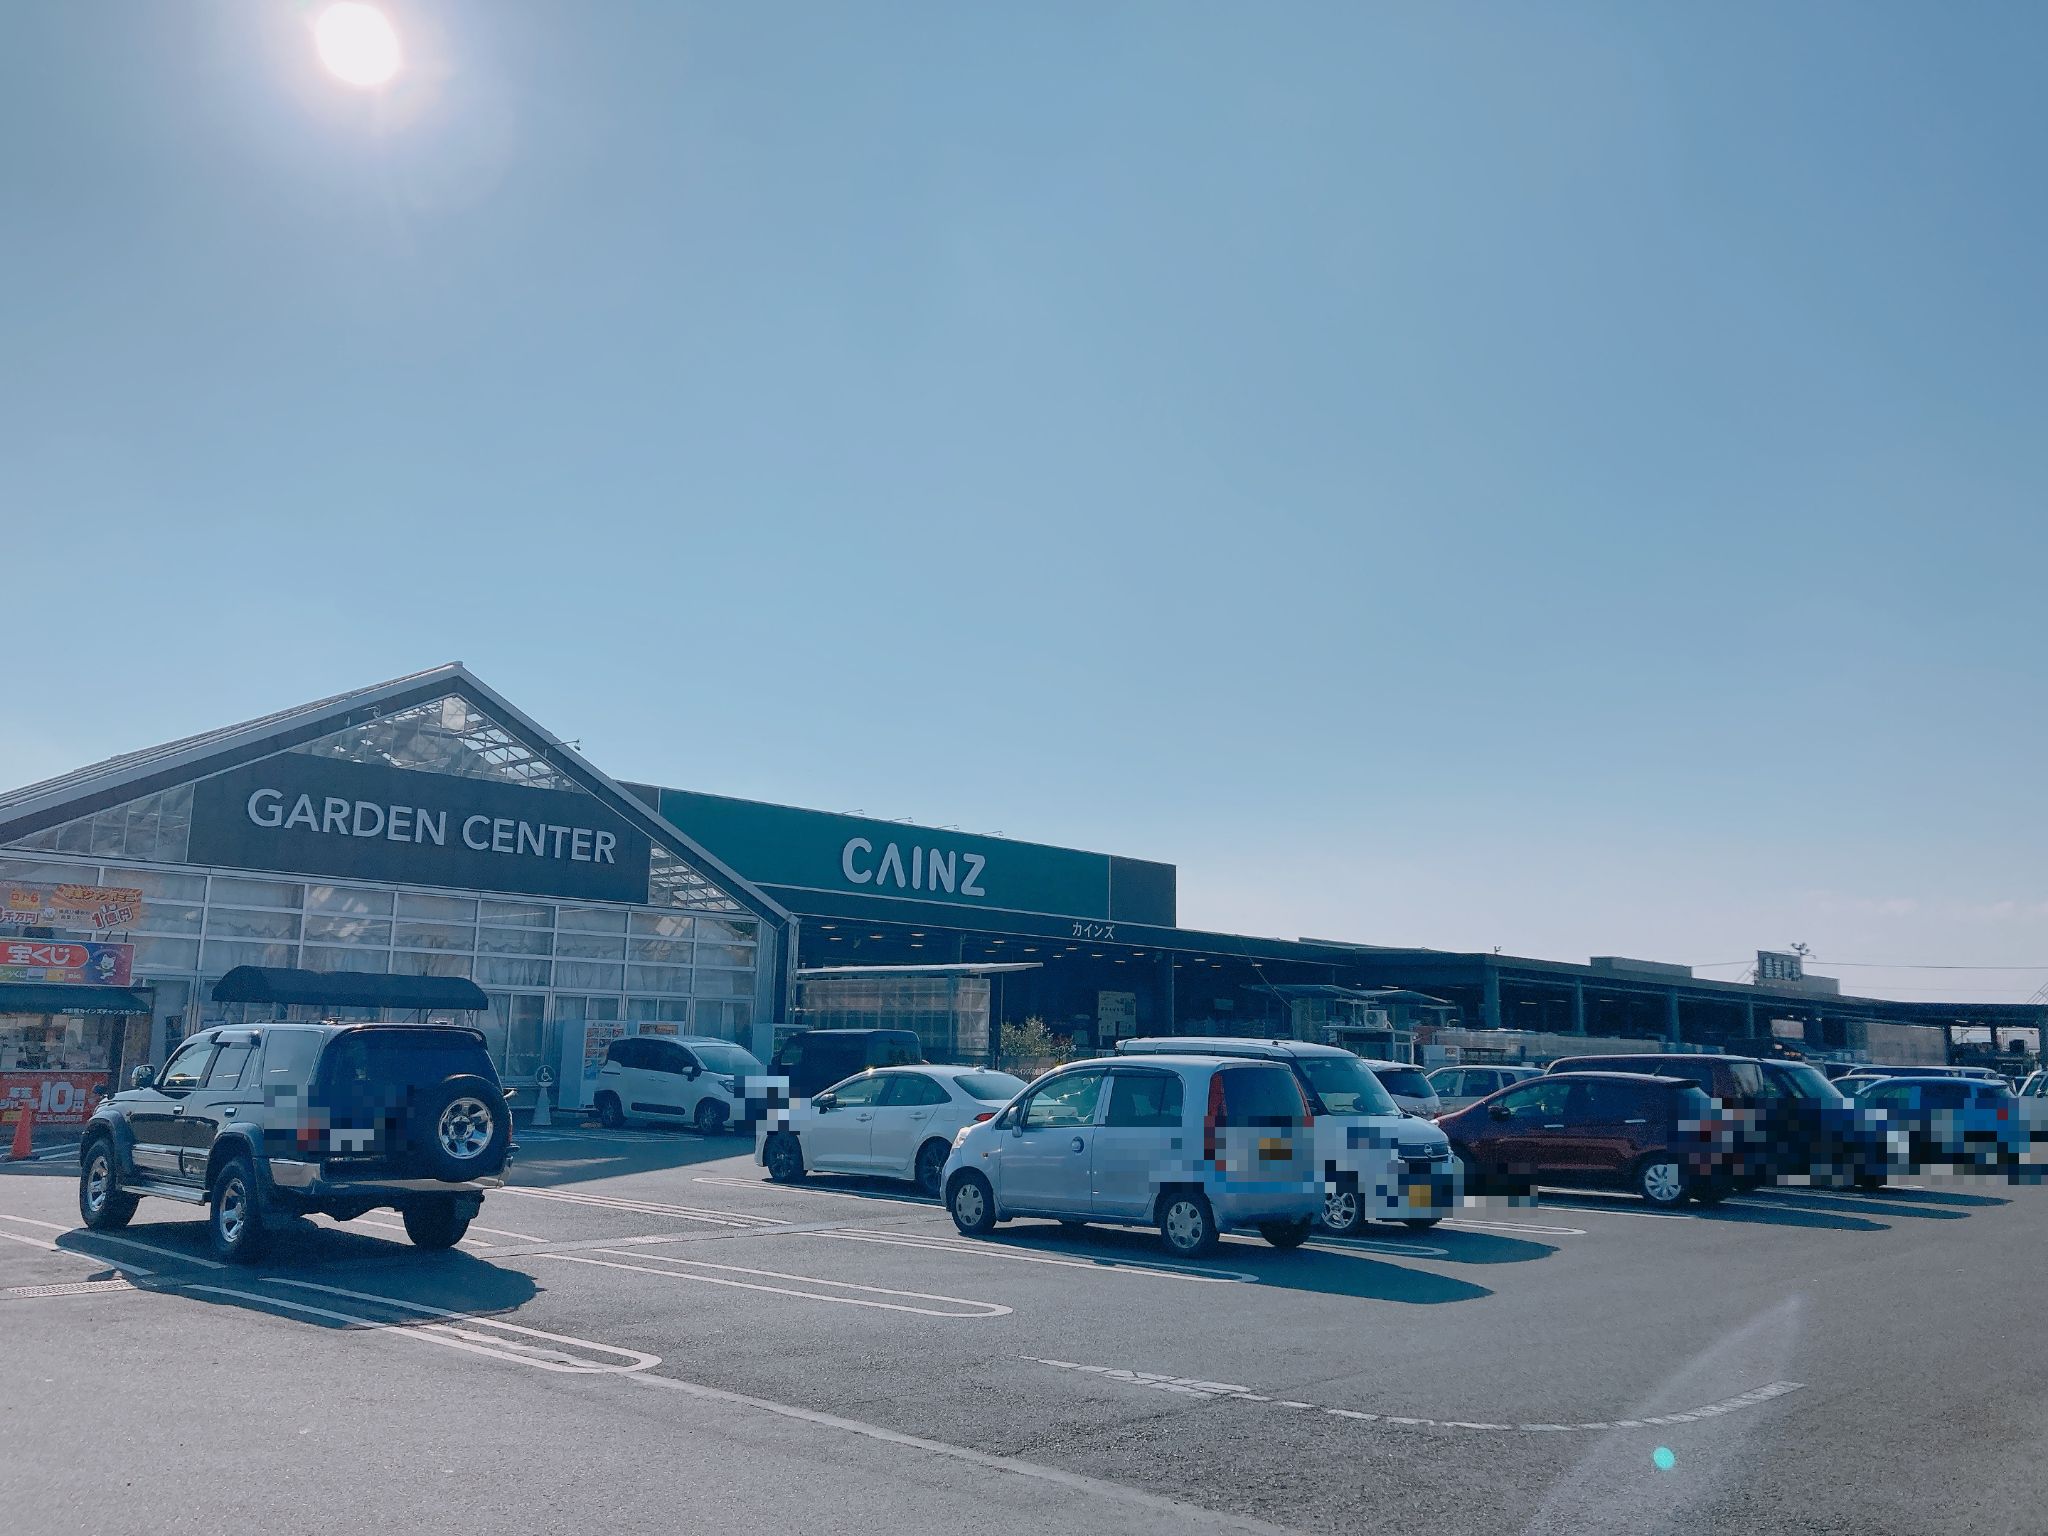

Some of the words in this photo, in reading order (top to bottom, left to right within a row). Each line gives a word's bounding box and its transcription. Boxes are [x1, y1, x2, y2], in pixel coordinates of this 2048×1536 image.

[247, 788, 447, 846] GARDEN
[462, 815, 617, 864] CENTER
[842, 837, 986, 897] CAINZ
[1072, 921, 1115, 940] カインズ
[8, 944, 71, 965] 宝くじ
